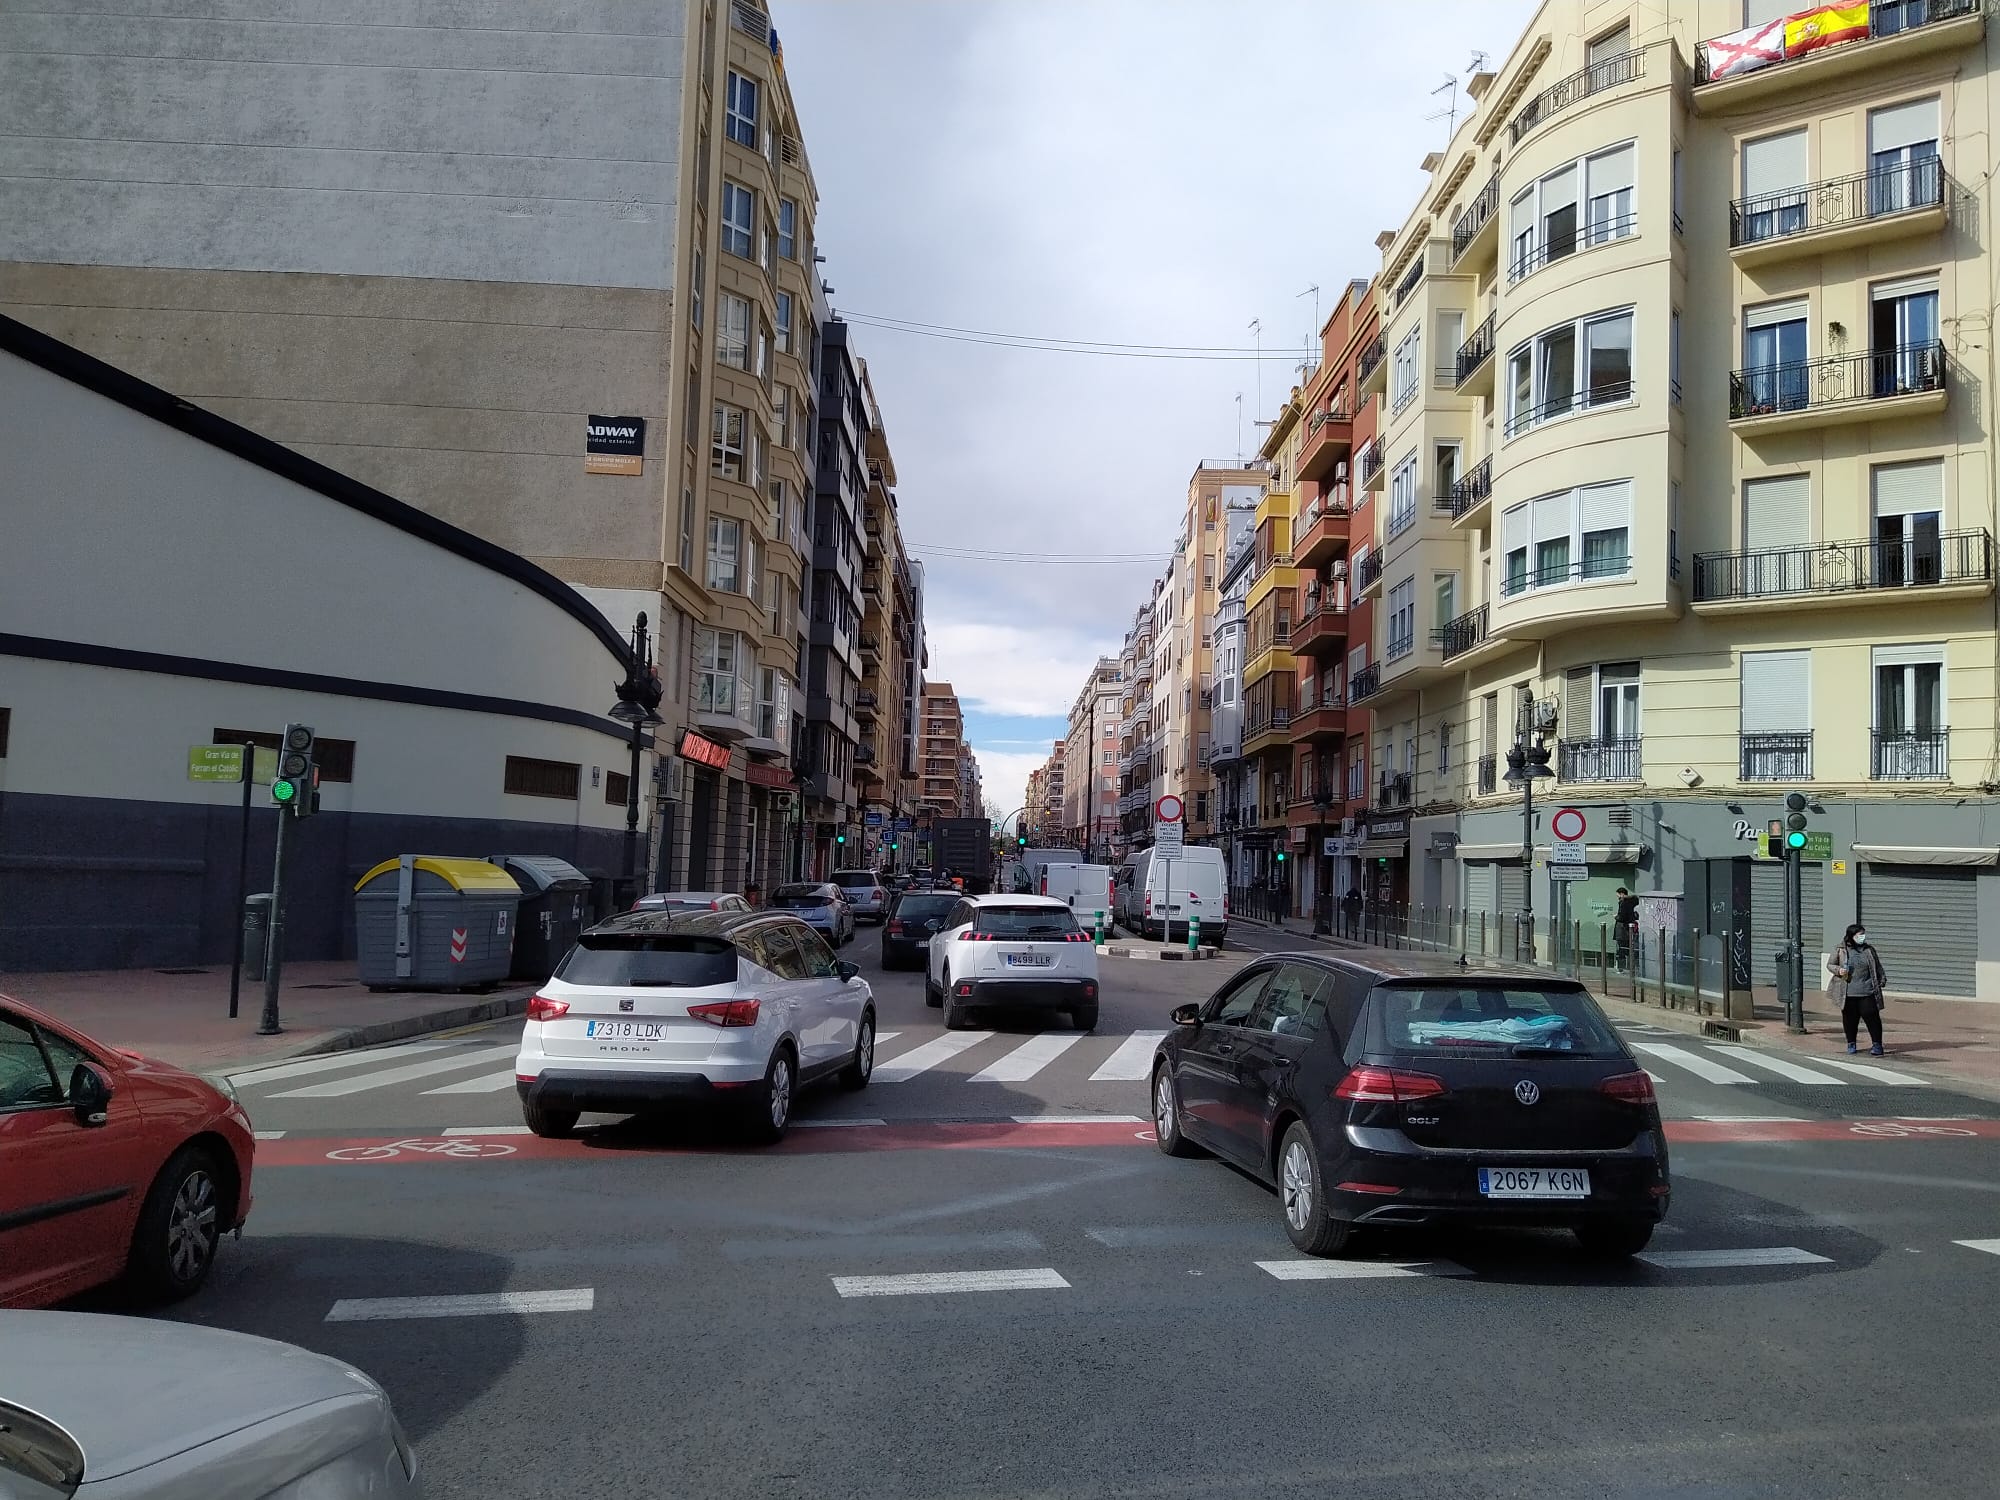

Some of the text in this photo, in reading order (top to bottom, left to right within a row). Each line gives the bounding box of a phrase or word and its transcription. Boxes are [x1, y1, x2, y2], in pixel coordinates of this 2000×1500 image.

[596, 1023, 663, 1037] 7318 LDK
[1407, 1117, 1440, 1125] GOLF
[1492, 1171, 1584, 1191] 2067 KGN
